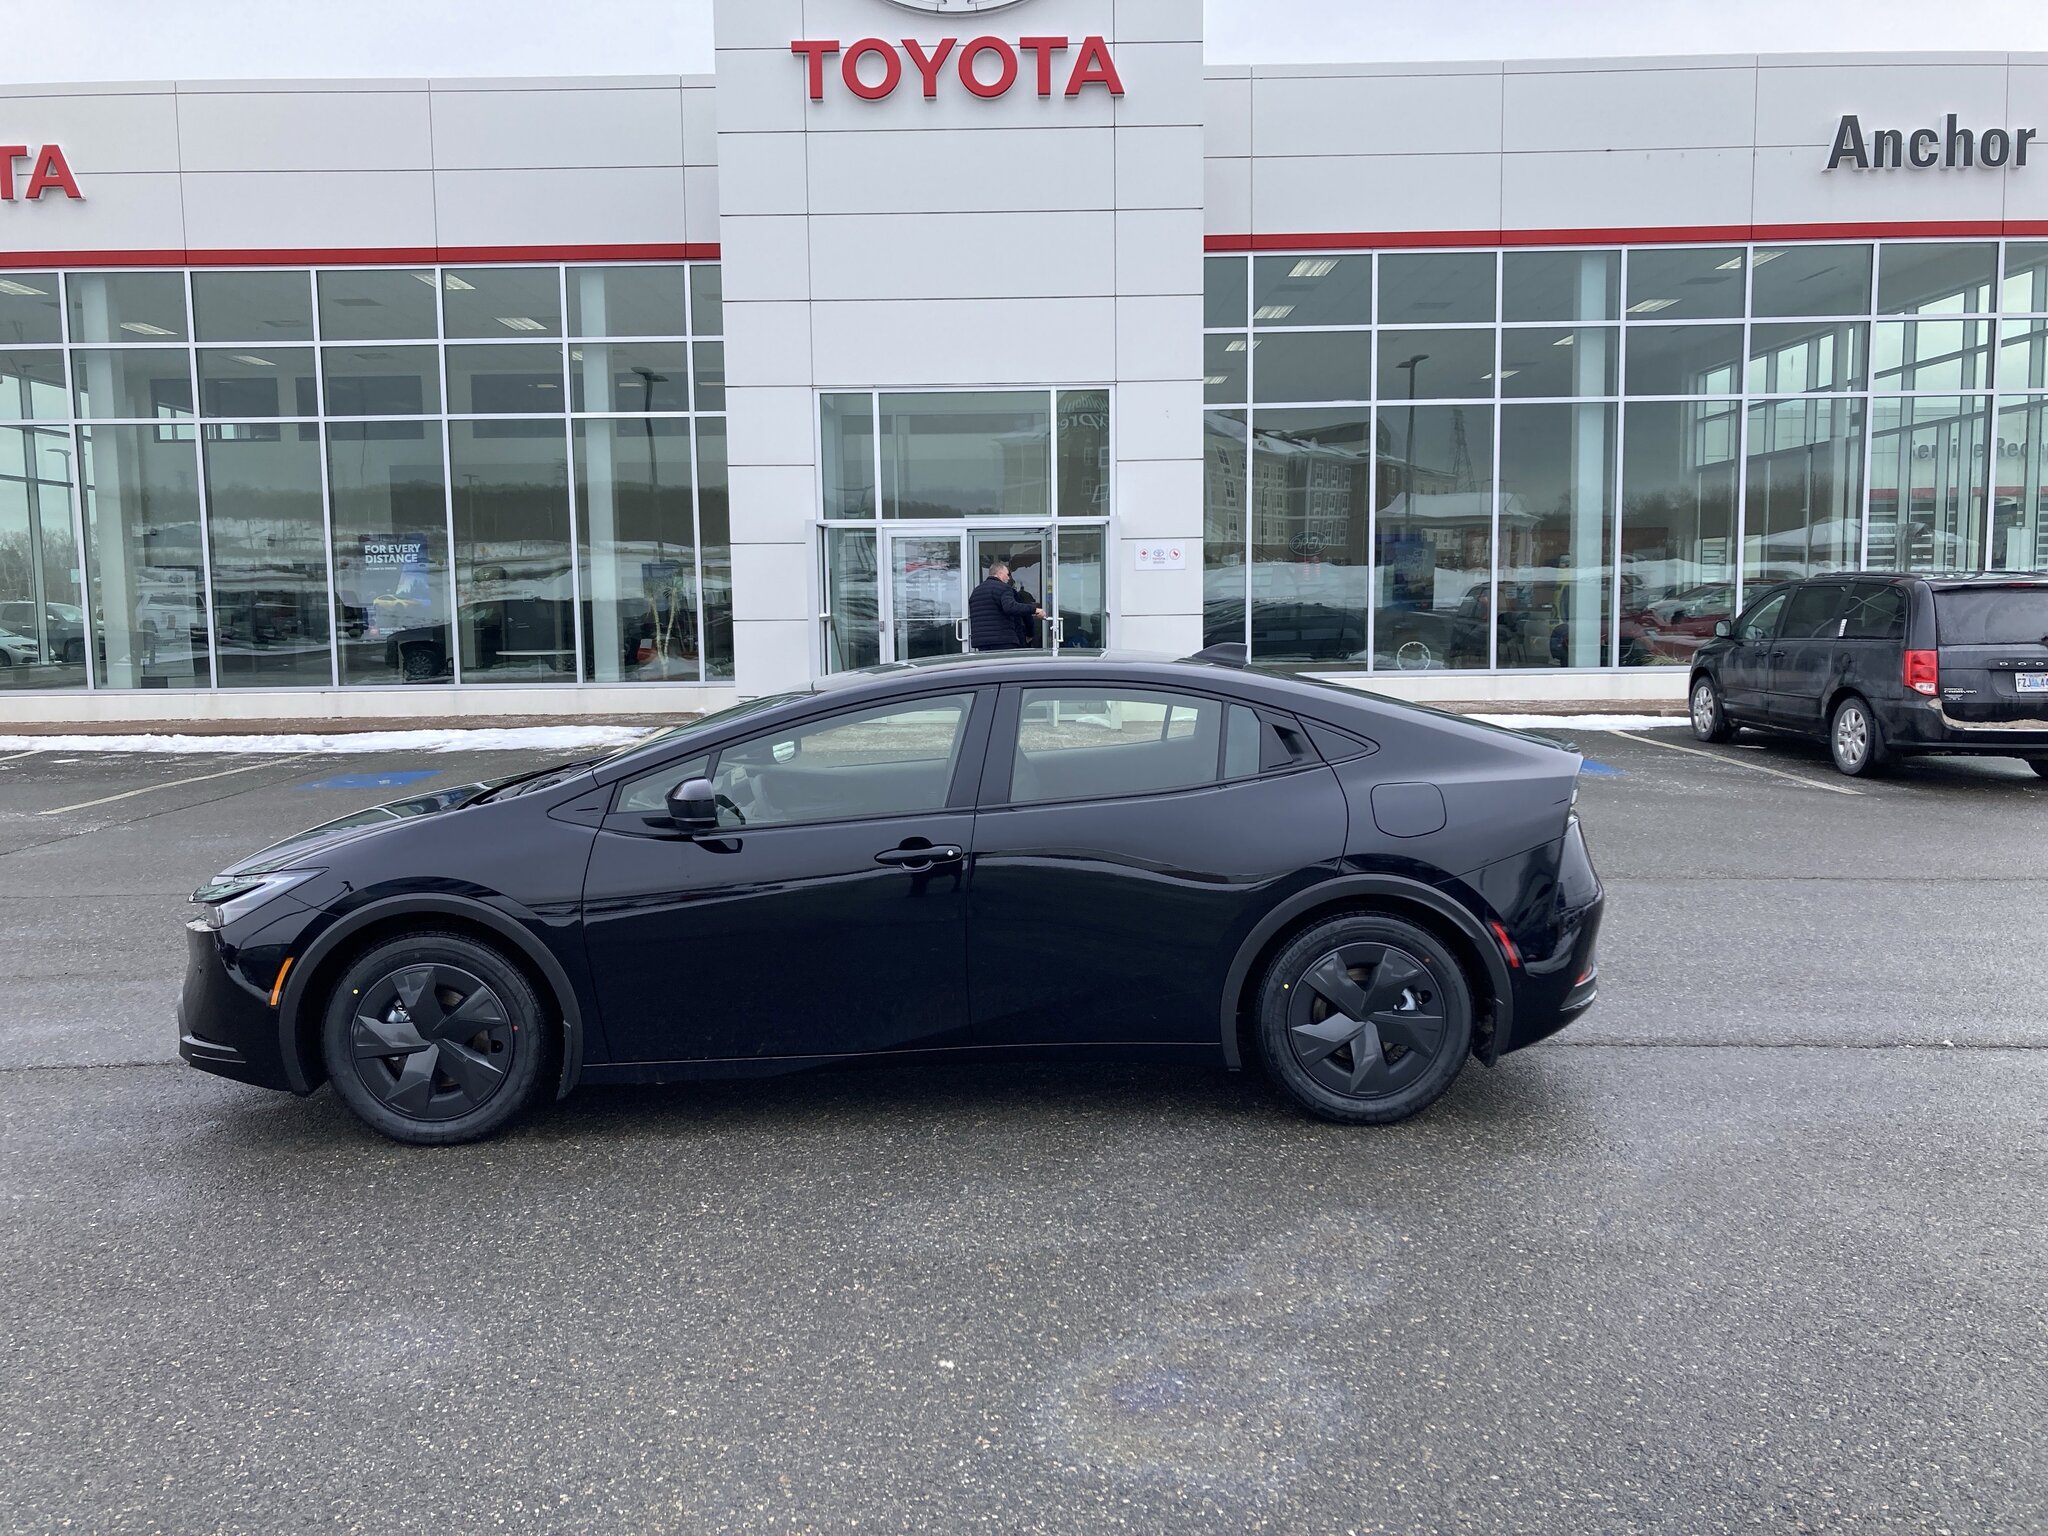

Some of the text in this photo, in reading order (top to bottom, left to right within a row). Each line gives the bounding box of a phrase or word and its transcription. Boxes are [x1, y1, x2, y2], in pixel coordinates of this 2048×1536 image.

[790, 36, 1125, 101] TOYOTA
[1826, 113, 2036, 169] Anchor
[364, 543, 421, 554] FOR EVERY
[1291, 536, 1324, 550] OPEN
[365, 553, 418, 563] DISTANCE
[2017, 678, 2032, 688] FZJ
